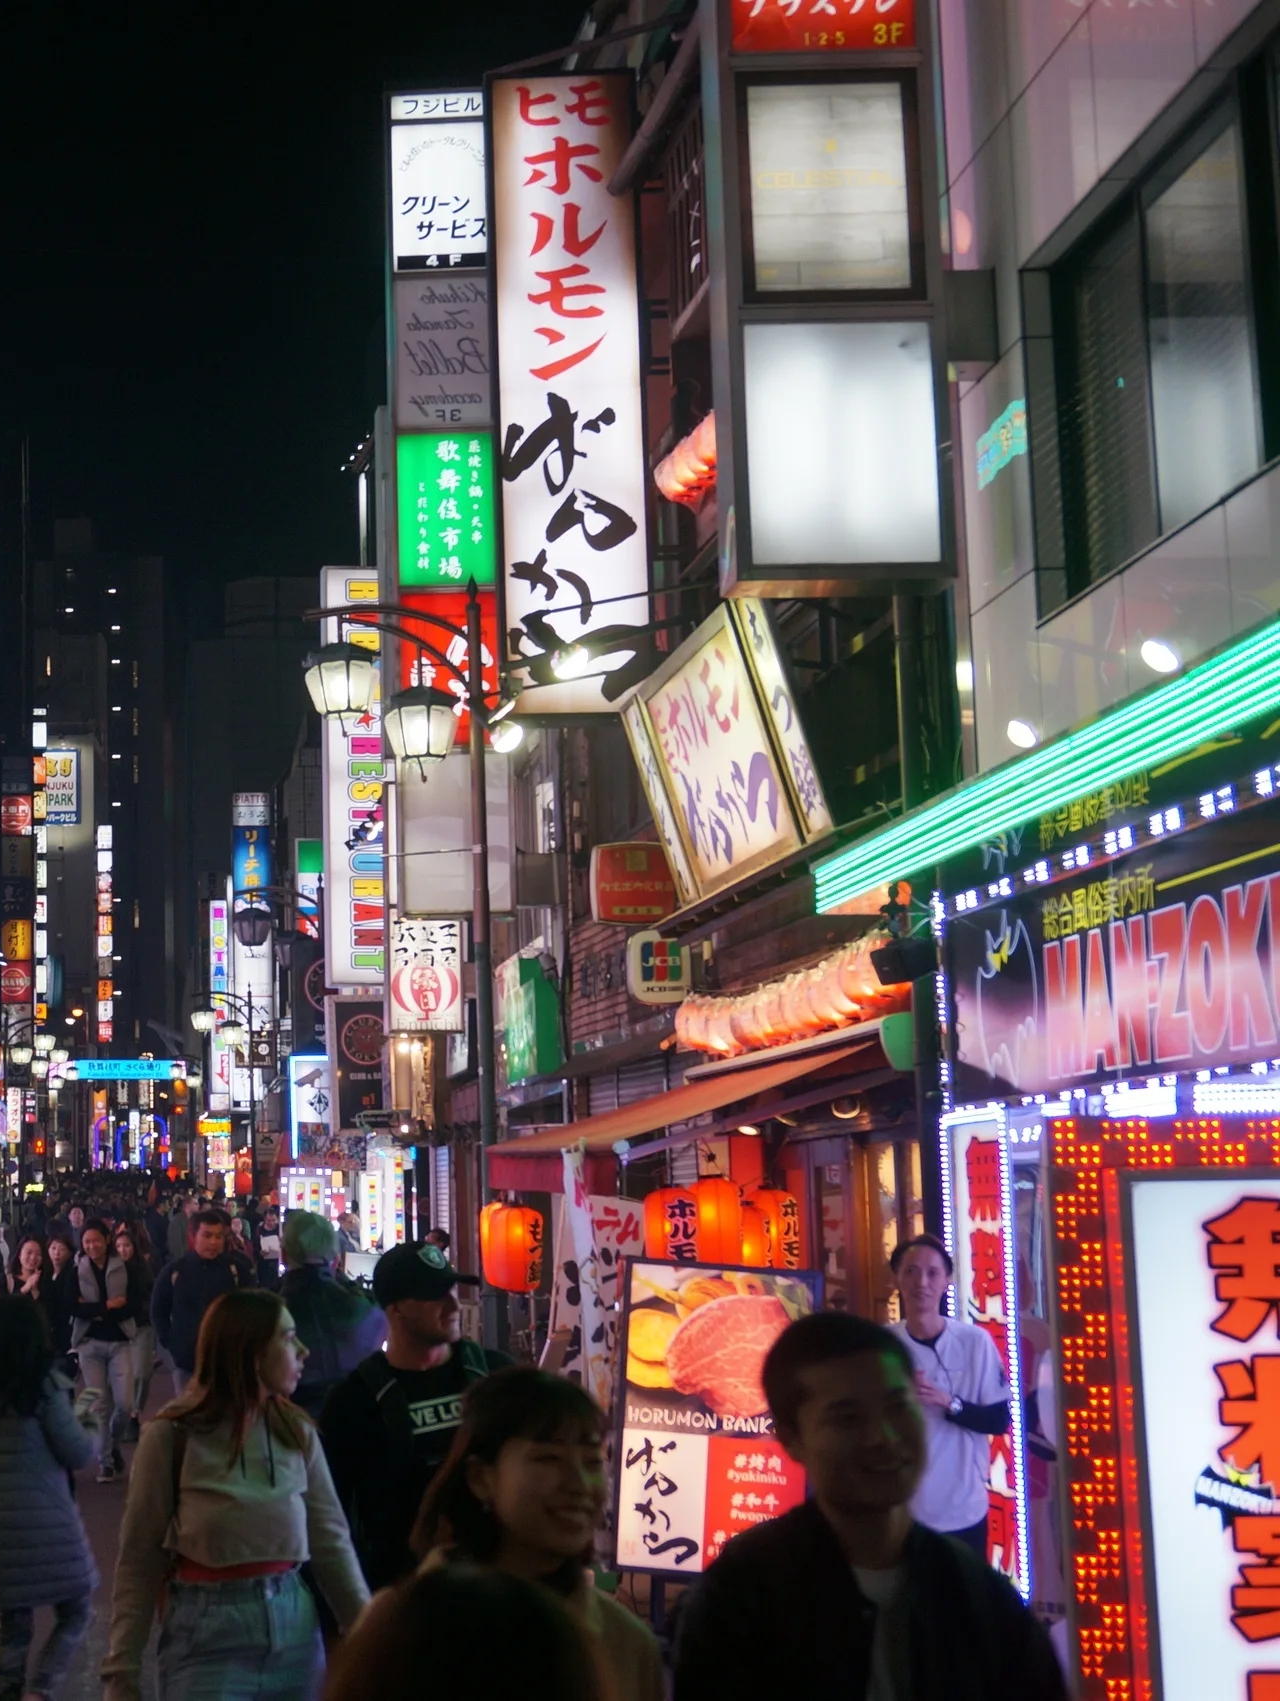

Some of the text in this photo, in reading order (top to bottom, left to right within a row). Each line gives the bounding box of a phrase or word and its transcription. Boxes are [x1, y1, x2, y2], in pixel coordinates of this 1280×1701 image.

[872, 21, 906, 45] 3F
[402, 97, 482, 115] フジビル
[401, 195, 471, 216] クリーン
[416, 217, 486, 240] サービス
[434, 439, 463, 581] 歌舞伎市場
[44, 781, 74, 791] NJUKU
[46, 793, 74, 806] PARK
[234, 794, 268, 804] PIATTO
[46, 813, 77, 823] パークビル
[642, 956, 681, 967] JCB
[10, 1088, 21, 1126] カラオケ
[666, 1198, 698, 1261] ホルモ
[627, 1405, 777, 1435] HORUMON BANK
[726, 1469, 788, 1486] #yakiniku
[730, 1492, 780, 1512] #和牛
